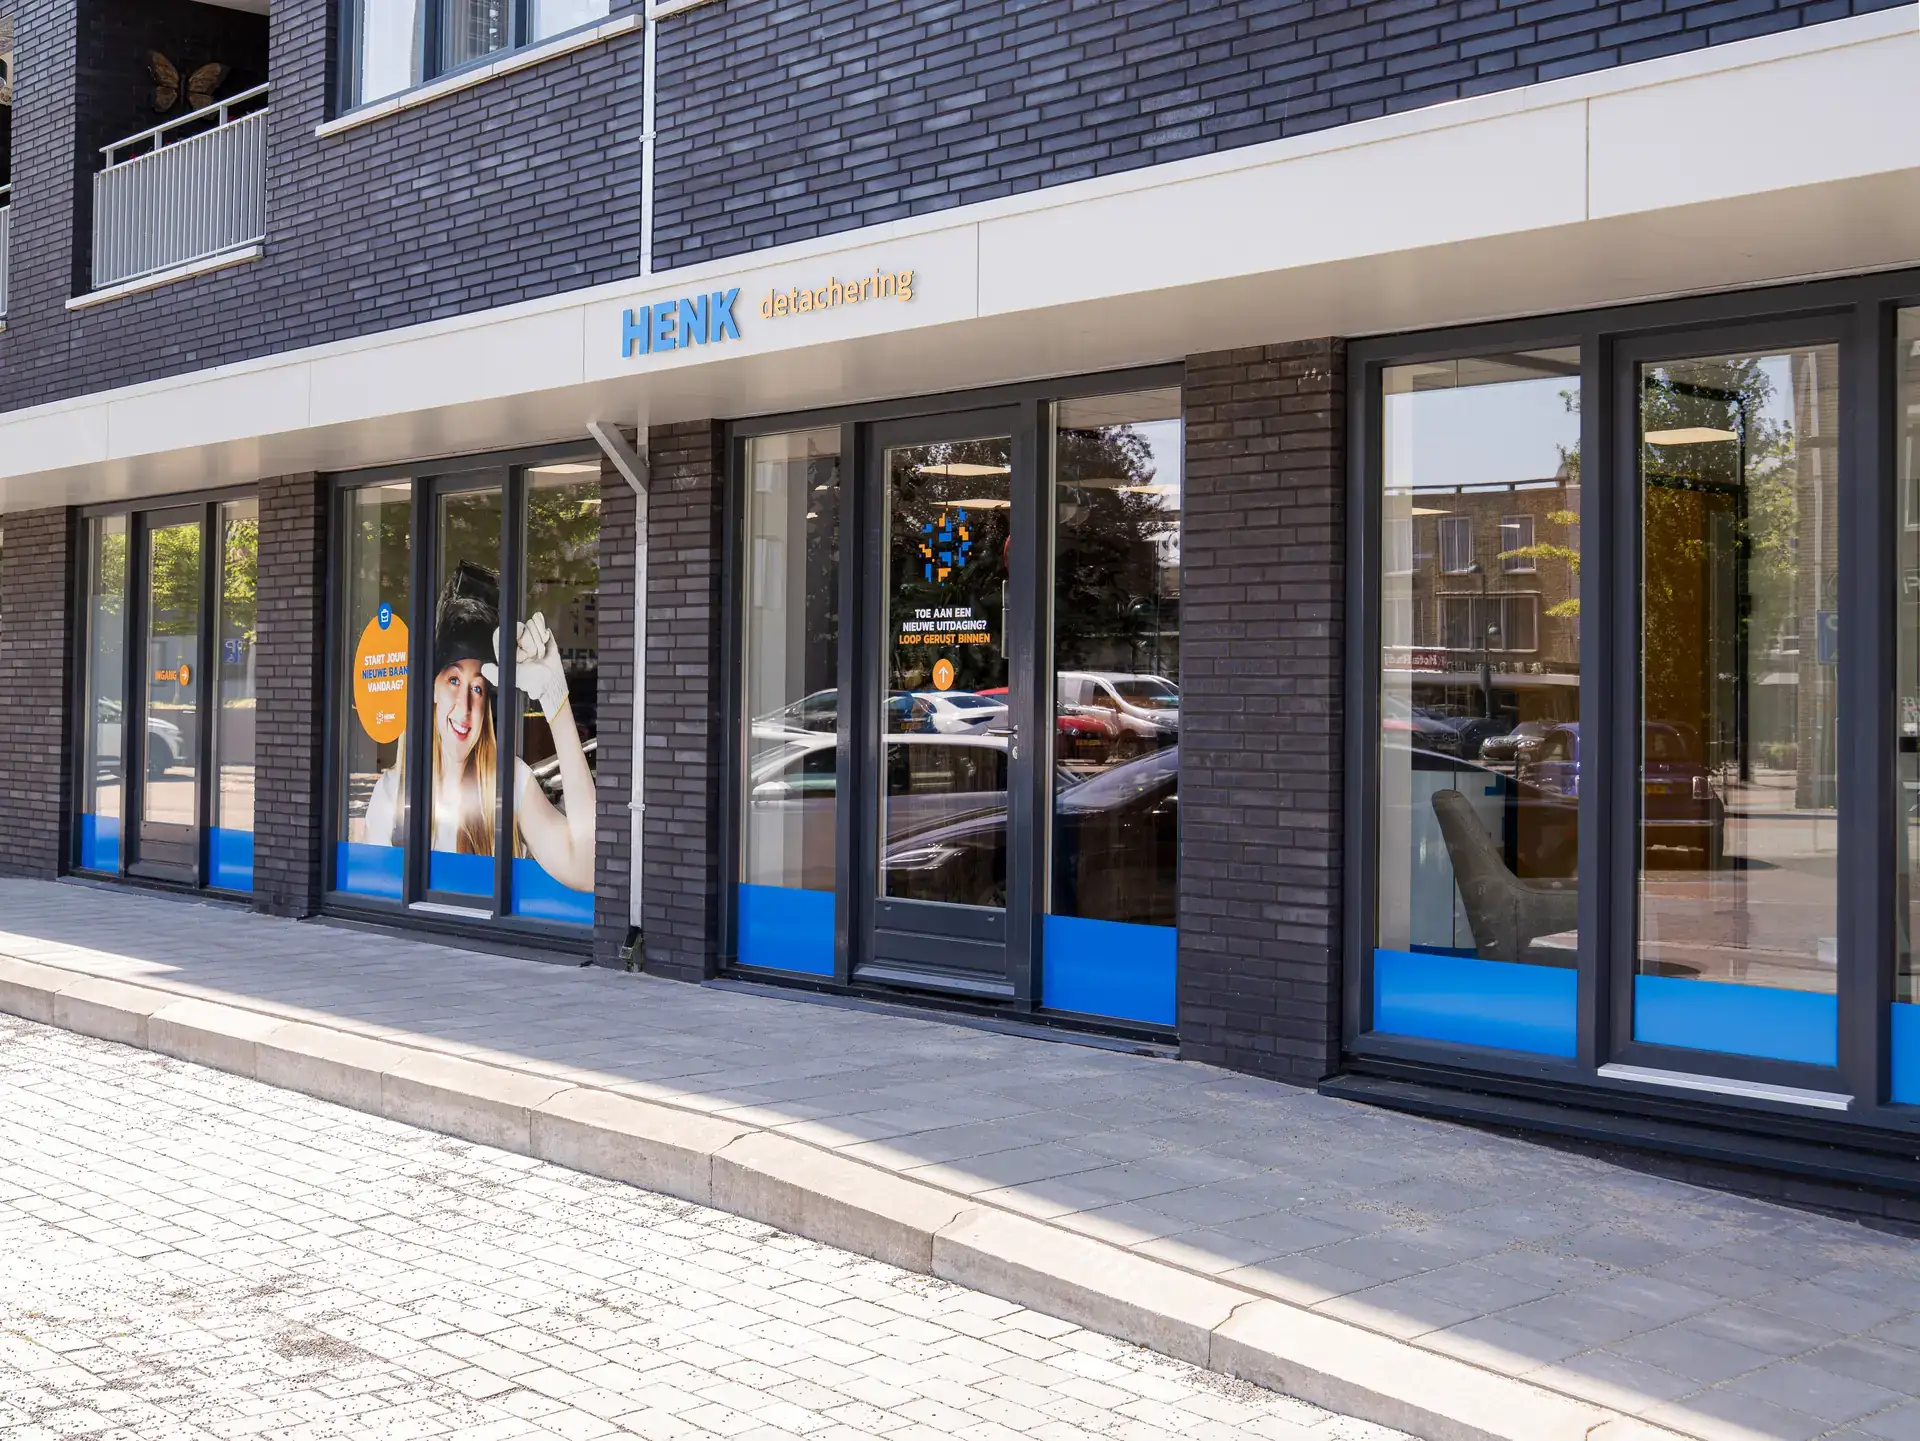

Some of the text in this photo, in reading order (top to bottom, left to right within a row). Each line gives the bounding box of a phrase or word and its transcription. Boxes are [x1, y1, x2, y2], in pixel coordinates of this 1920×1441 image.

[621, 267, 914, 358] HENK detachering
[914, 607, 971, 619] TOE AAN EEN
[902, 620, 987, 632] NIEUWE UITDAGING?
[899, 633, 990, 645] LOOP GERUST BINNEN
[364, 652, 406, 666] START JOUW
[362, 665, 408, 679] NIEUWE BAAN
[367, 679, 404, 692] VANDAAG?
